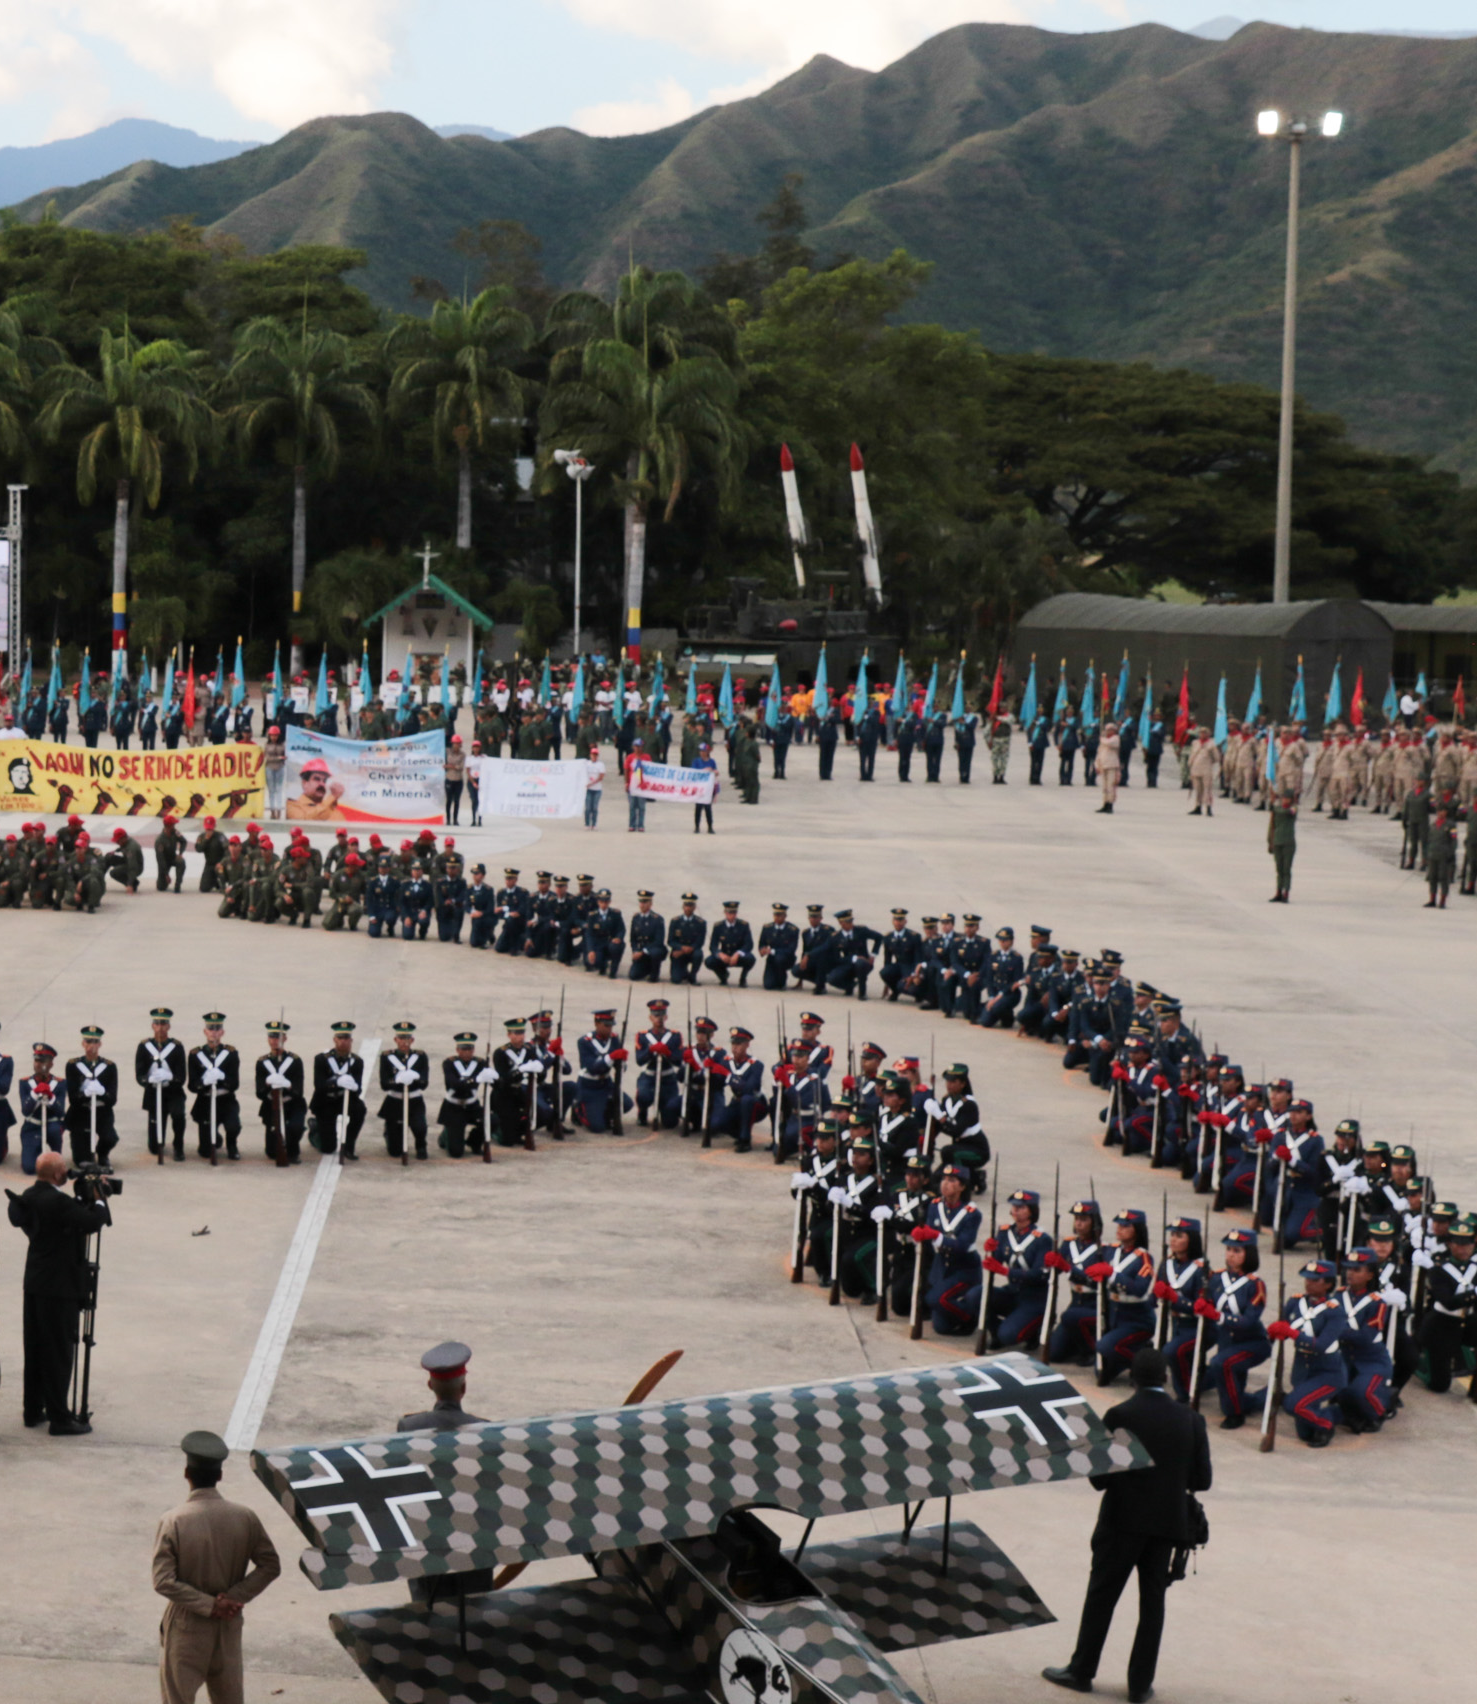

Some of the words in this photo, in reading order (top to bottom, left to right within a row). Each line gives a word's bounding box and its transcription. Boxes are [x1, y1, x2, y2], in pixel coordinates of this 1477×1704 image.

[393, 758, 444, 766] Potencia
[89, 754, 114, 778] NO
[118, 755, 141, 781] SE
[144, 754, 195, 781] RINDE
[368, 772, 427, 782] Chavista
